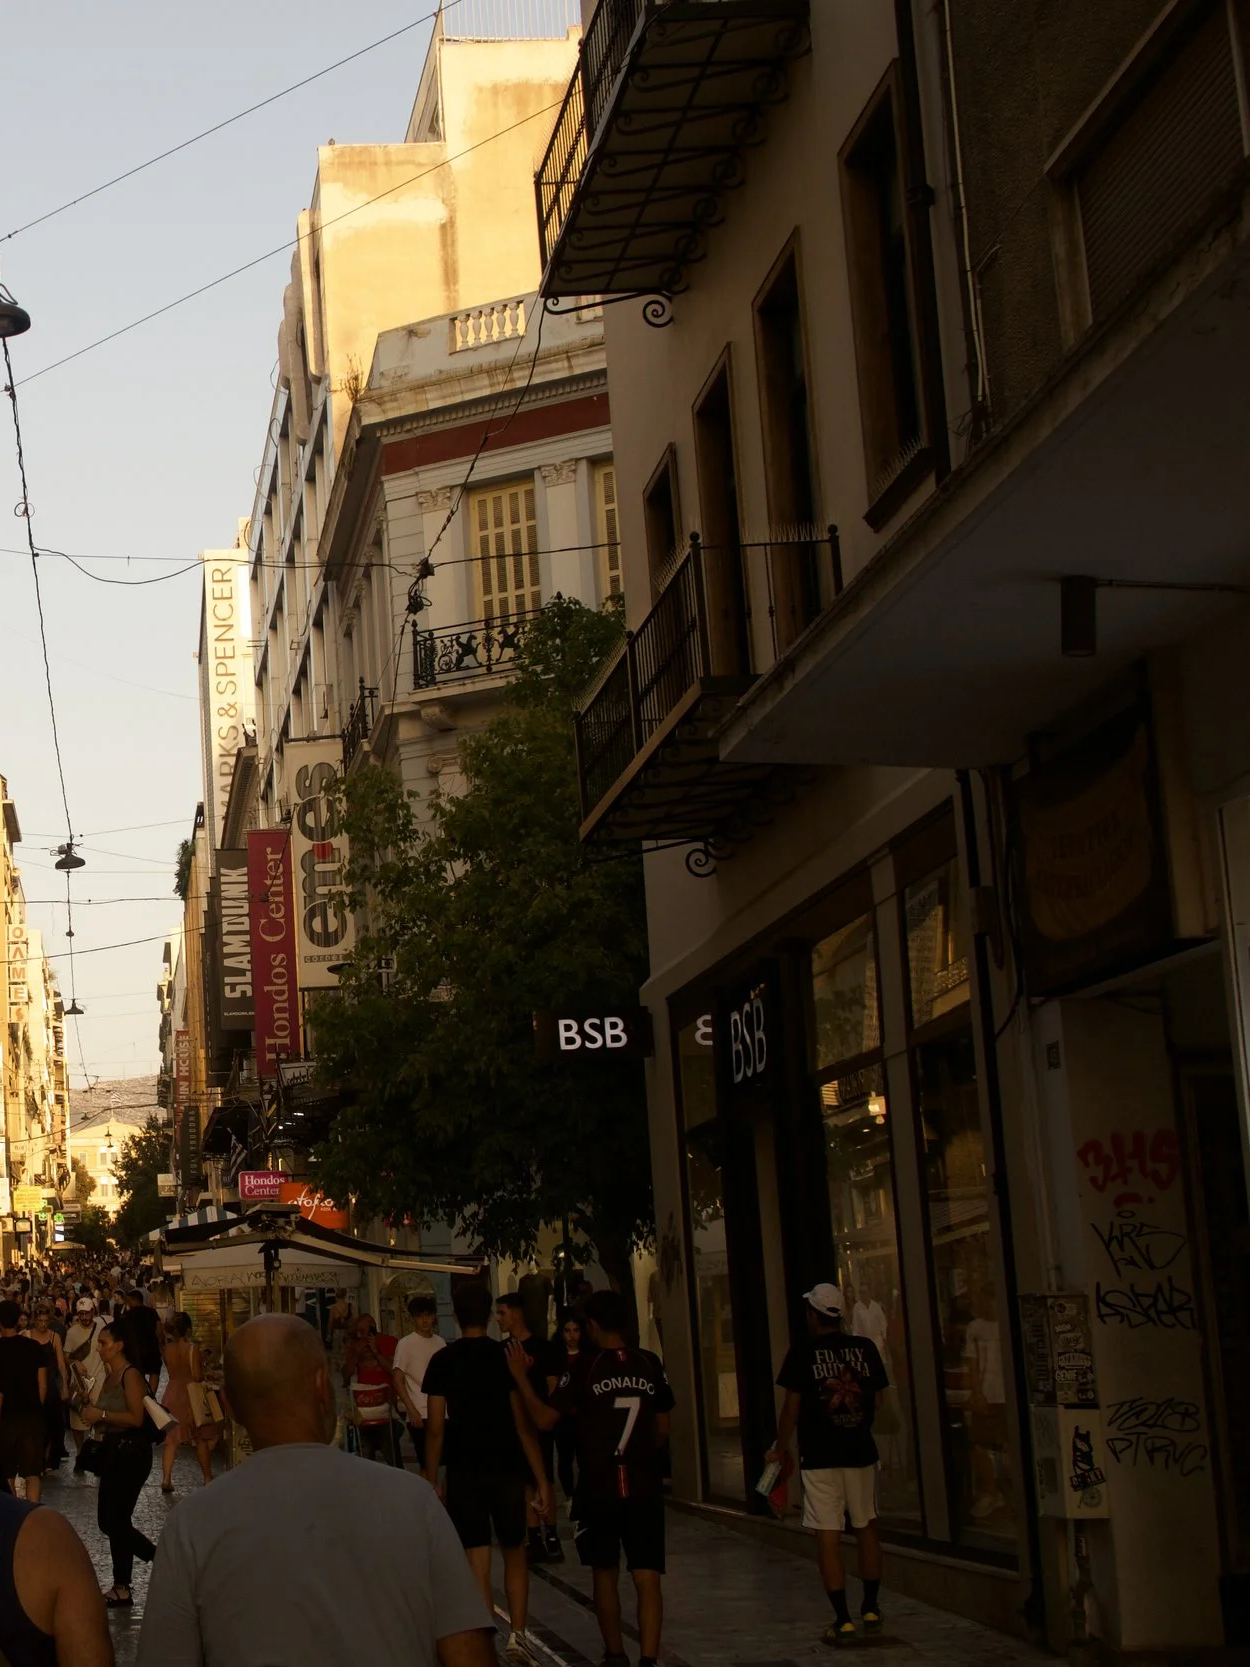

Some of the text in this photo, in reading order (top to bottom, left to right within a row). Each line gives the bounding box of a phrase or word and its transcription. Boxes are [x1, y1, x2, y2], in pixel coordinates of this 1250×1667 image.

[212, 567, 237, 695] SPENCER
[217, 702, 237, 718] &
[220, 867, 253, 998] SLAMDUNK
[259, 847, 290, 1063] Hondos Center
[558, 1017, 628, 1050] BSB
[730, 998, 767, 1084] BSB
[244, 1175, 285, 1186] Hondos
[244, 1184, 279, 1196] Center
[592, 1377, 656, 1396] RONALDO
[613, 1396, 641, 1456] 7
